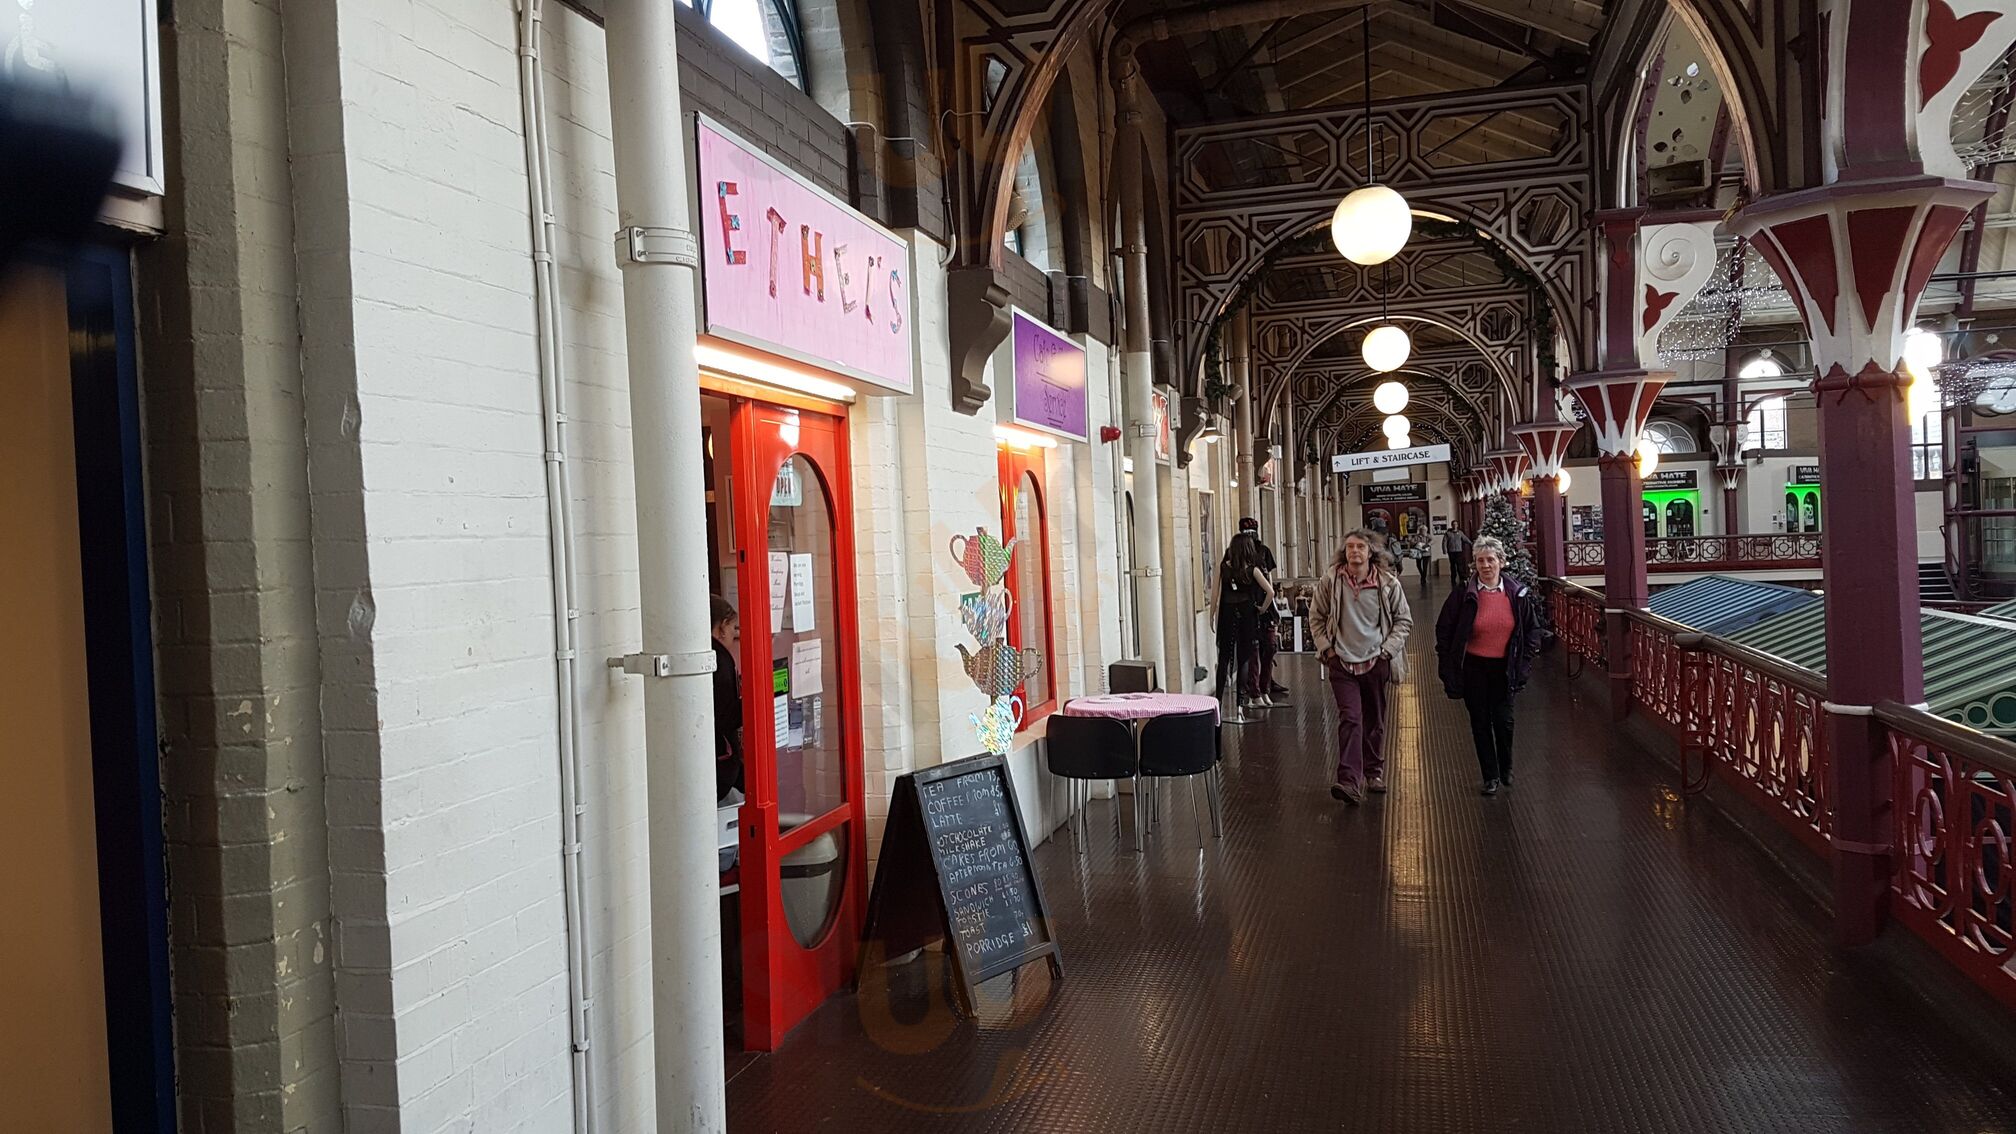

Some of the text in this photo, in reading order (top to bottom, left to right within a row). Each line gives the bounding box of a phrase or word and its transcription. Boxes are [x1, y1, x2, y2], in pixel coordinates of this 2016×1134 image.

[1351, 457, 1370, 466] LIFT
[1381, 450, 1431, 463] STAIRCASE
[922, 782, 944, 799] TEA
[957, 772, 984, 788] FROM
[928, 795, 964, 815] COFFEE
[932, 813, 963, 828] LATTE
[948, 825, 992, 844] CHOCOLATE
[938, 836, 986, 856] MILKSHAKE
[944, 853, 975, 870] CAKES
[978, 844, 1006, 862] FROM
[949, 864, 991, 884] AFTERNOON
[992, 861, 1008, 872] TEA
[950, 882, 989, 906] SCONES
[954, 895, 994, 921] SANDWICH
[958, 908, 990, 927] TOASTIE
[960, 922, 986, 941] TOAST
[966, 932, 1014, 959] PORRIDGE
